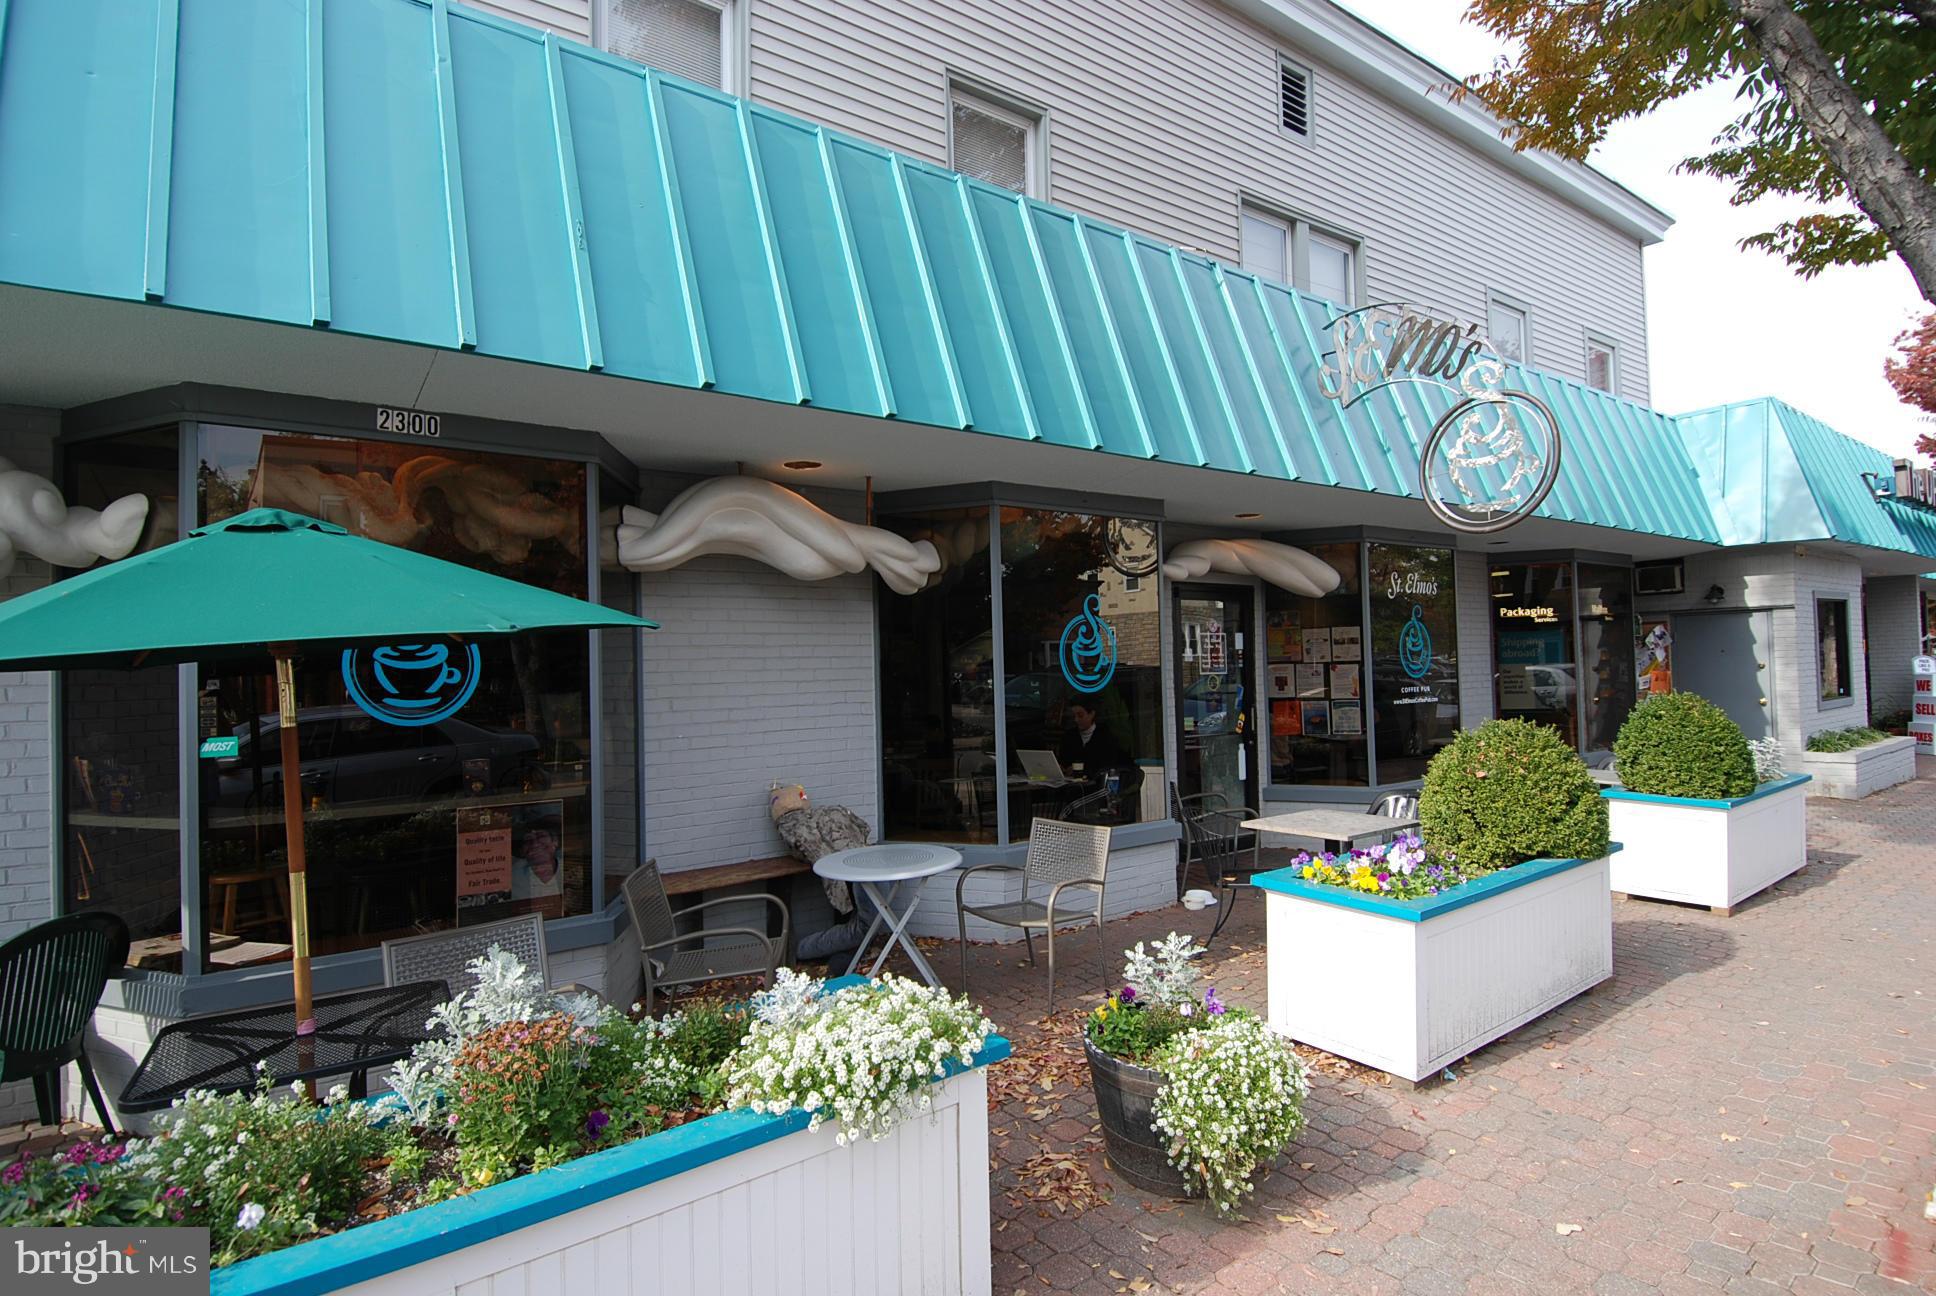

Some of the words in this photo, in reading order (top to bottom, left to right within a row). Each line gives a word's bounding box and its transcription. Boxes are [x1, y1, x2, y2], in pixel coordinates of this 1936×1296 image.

[379, 409, 439, 436] 2300
[1387, 571, 1404, 599] St.
[1405, 572, 1438, 595] Elmo's
[1500, 606, 1554, 617] Packaging
[1915, 680, 1931, 691] WE
[1915, 703, 1935, 715] SELL
[201, 741, 236, 753] MOST
[465, 836, 487, 845] Quality
[464, 858, 487, 866] Quality
[482, 878, 500, 886] Trade
